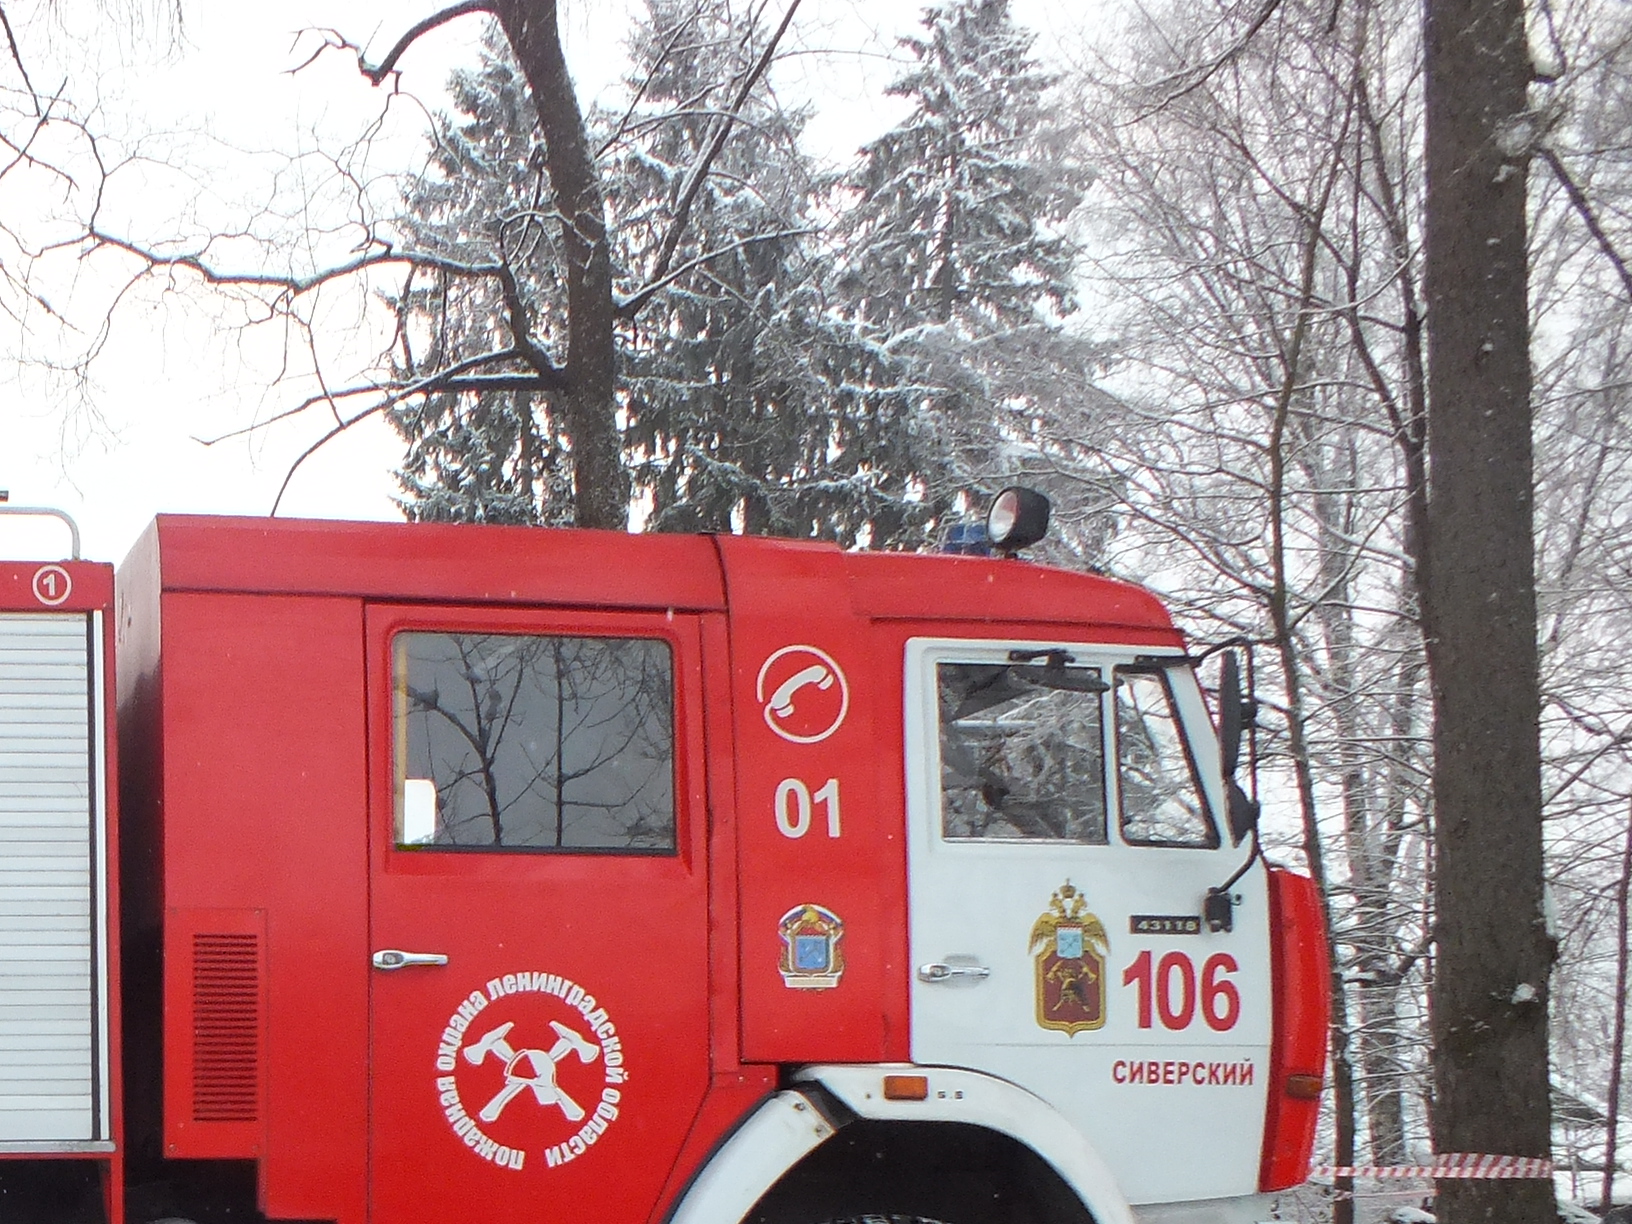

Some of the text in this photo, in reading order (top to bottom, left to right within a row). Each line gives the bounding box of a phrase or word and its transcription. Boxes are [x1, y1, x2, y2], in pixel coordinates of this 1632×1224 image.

[42, 573, 55, 596] 1
[773, 777, 842, 840] 01
[1137, 920, 1198, 931] 43118
[1122, 950, 1241, 1032] 106
[436, 990, 489, 1071] охрана
[1112, 1057, 1255, 1086] СИВЕРСКИЙ
[436, 1076, 526, 1170] пожарная
[544, 1087, 621, 1168] области
